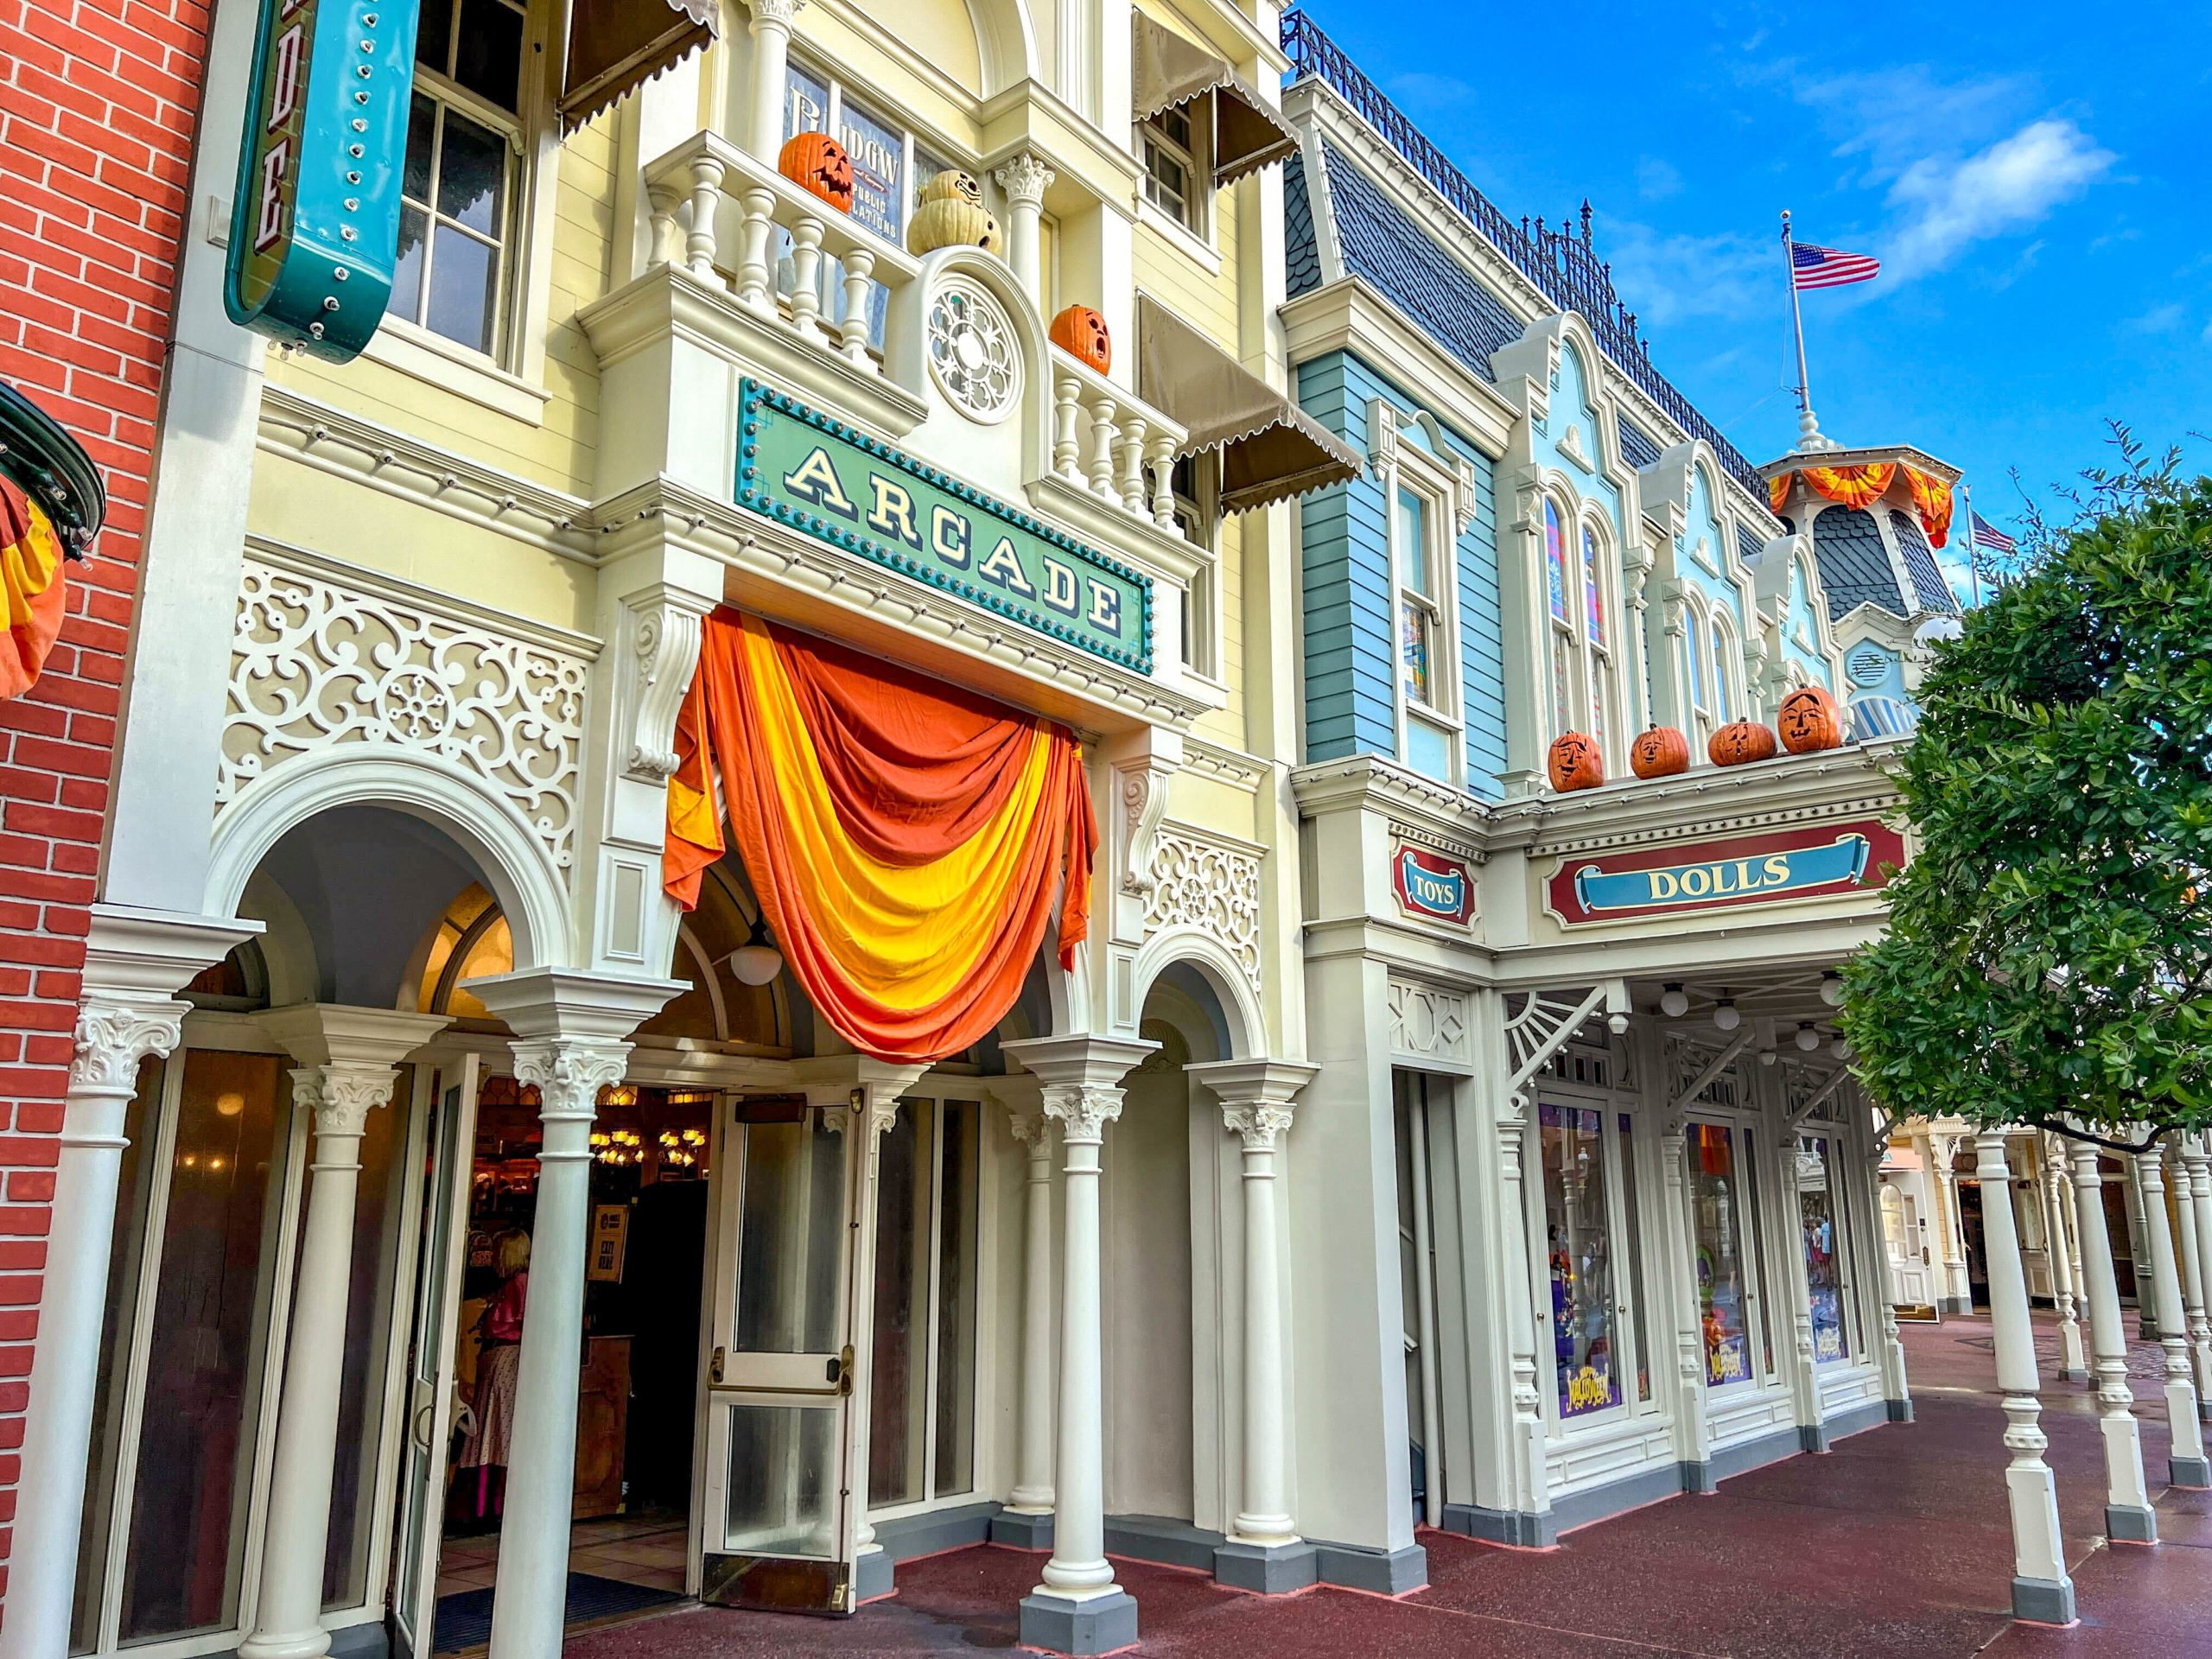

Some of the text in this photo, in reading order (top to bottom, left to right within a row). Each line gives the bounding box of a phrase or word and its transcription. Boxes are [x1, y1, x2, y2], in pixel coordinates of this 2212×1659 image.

[852, 182, 887, 214] PUBLIC
[850, 200, 896, 238] LATIONS
[783, 446, 1122, 638] ARCADE
[1414, 874, 1456, 905] TOYS
[1646, 855, 1791, 899] DOLLS
